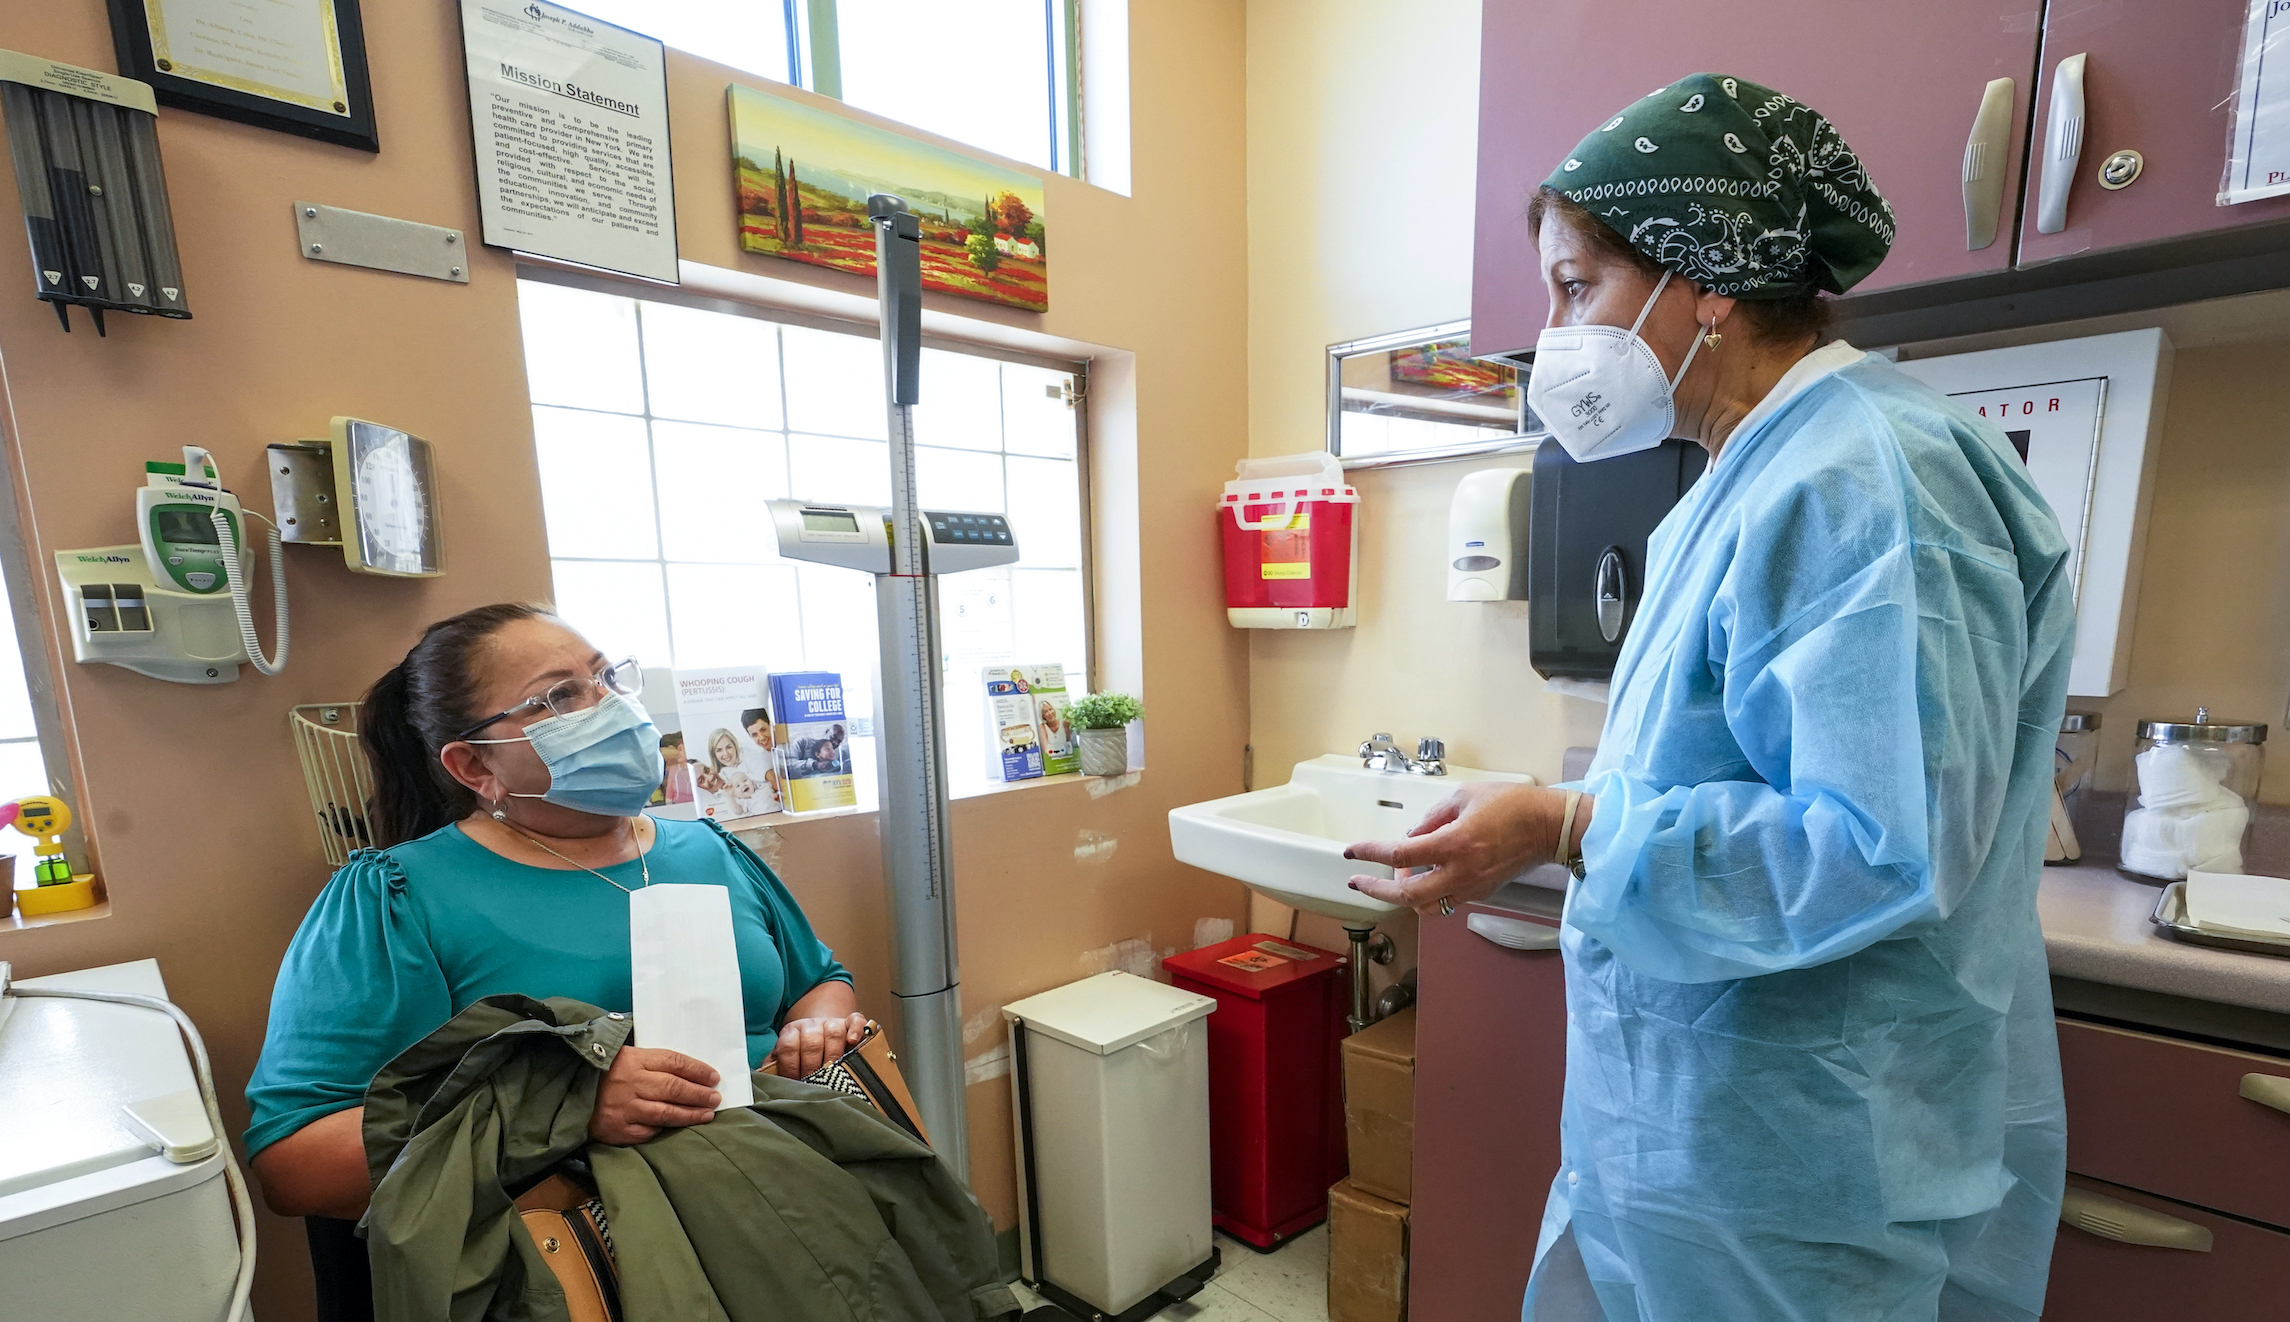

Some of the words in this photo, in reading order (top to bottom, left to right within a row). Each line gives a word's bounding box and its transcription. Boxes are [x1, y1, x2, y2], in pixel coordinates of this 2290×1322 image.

[541, 12, 560, 23] Joseph
[568, 22, 594, 34] Addabbo
[44, 71, 87, 85] DIAGNOSTIC
[91, 82, 112, 91] STYLE
[501, 63, 561, 92] Mission
[566, 83, 639, 115] Statement
[492, 103, 533, 119] preventive
[541, 117, 555, 125] and
[563, 123, 619, 143] comprehensive
[627, 141, 652, 152] primary
[493, 112, 517, 123] health
[521, 120, 537, 129] care
[541, 125, 572, 141] provider
[586, 136, 601, 146] New
[519, 102, 550, 114] mission
[607, 126, 618, 134] the
[627, 132, 652, 144] leading
[494, 122, 535, 138] committed
[552, 138, 587, 152] providing
[592, 149, 621, 160] services
[626, 157, 639, 165] that
[563, 149, 579, 158] high
[495, 141, 509, 149] and
[589, 164, 619, 177] Services
[496, 150, 530, 163] provided
[540, 161, 555, 169] with
[564, 167, 591, 179] respect
[498, 168, 510, 176] the
[518, 172, 567, 190] communities
[628, 199, 657, 211] Through
[588, 182, 622, 195] economic
[626, 191, 646, 201] needs
[501, 195, 512, 203] the
[521, 200, 569, 216] expectations
[612, 221, 639, 232] patients
[646, 228, 658, 236] and
[581, 205, 616, 219] anticipate
[619, 214, 632, 222] and
[634, 218, 658, 228] exceed
[619, 206, 657, 221] community
[959, 605, 965, 614] 5
[990, 596, 995, 604] 6
[680, 678, 725, 688] WHOOPING
[727, 676, 755, 684] COUGH
[795, 688, 824, 701] SAVING
[825, 688, 841, 700] FOR
[808, 700, 842, 713] COLLEGE
